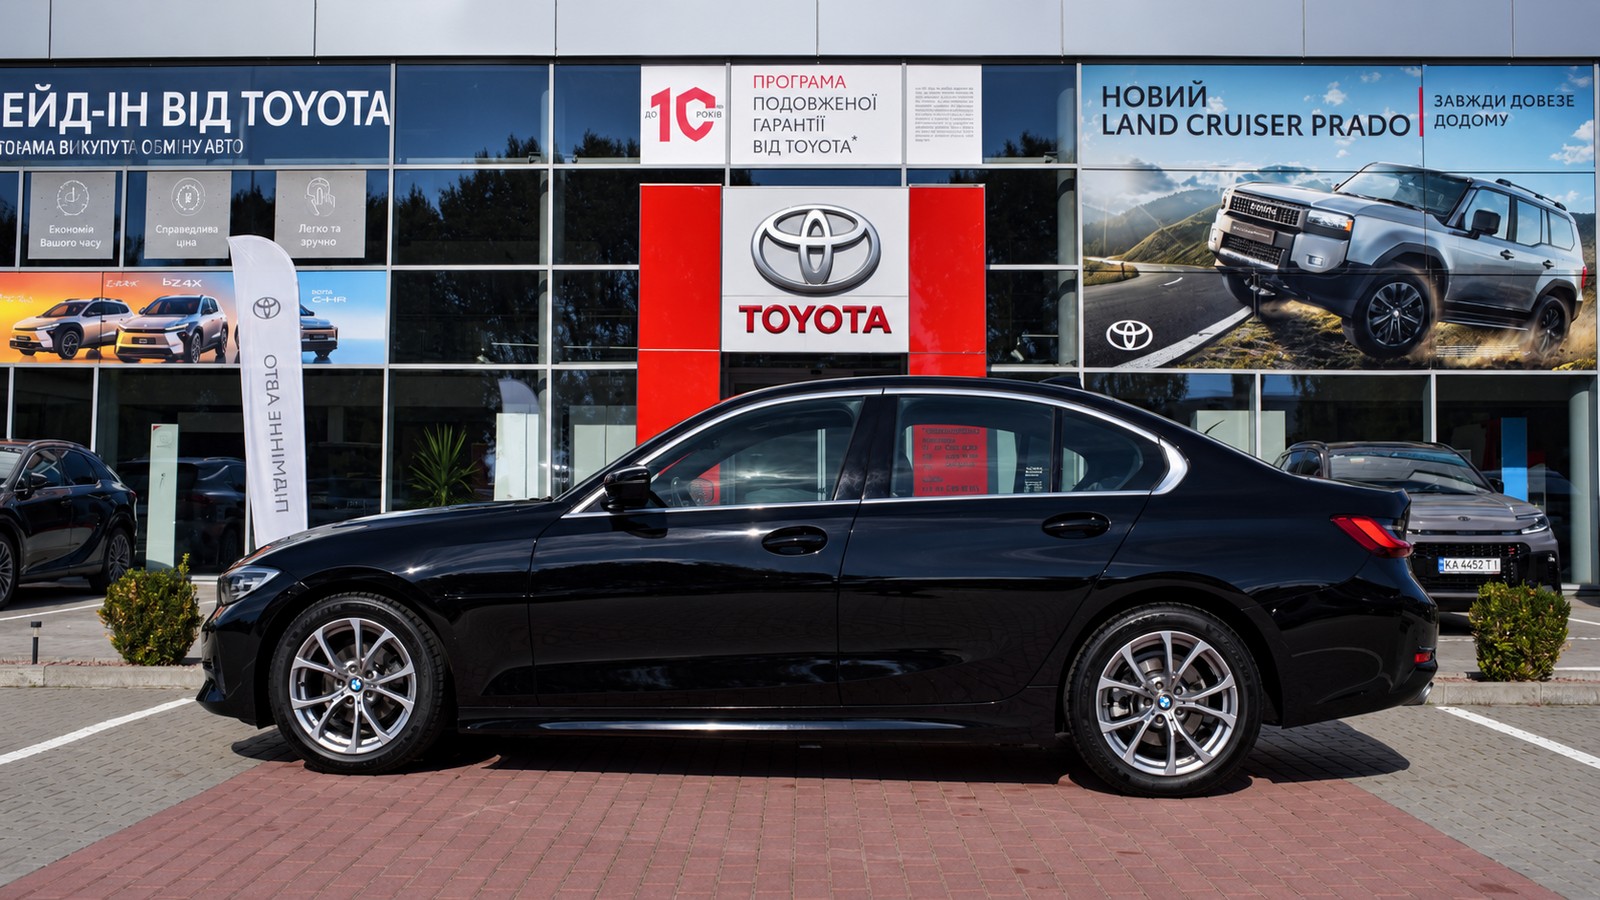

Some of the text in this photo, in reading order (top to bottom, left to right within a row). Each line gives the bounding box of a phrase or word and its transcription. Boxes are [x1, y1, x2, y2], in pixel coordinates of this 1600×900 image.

[753, 74, 847, 89] ПРОГРАМА
[1102, 80, 1208, 109] НОВИЙ
[1434, 94, 1576, 110] ЗАВЖДИ ДОВЕЗЕ
[2, 83, 391, 135] ЕЙД-ІН ВІД TOYOTA
[753, 93, 878, 114] ПОДОВЖЕНОЇ
[644, 111, 658, 120] ДО
[696, 110, 722, 119] РОКІВ
[1434, 113, 1509, 129] ДОДОМУ
[753, 115, 826, 133] ГАРАНТІЇ
[1102, 113, 1411, 137] LAND CRUISER PRADO
[204, 138, 244, 154] АВТО
[753, 139, 782, 157] ВІД
[49, 224, 94, 234] Економія
[155, 224, 219, 236] Справедлива
[298, 224, 328, 234] Легко
[40, 238, 102, 250] Вашого часу
[300, 239, 337, 249] зручно
[162, 277, 202, 288] bZ4X
[738, 304, 893, 335] TOYOTA
[1444, 559, 1459, 570] KA
[1460, 559, 1484, 570] 4452
